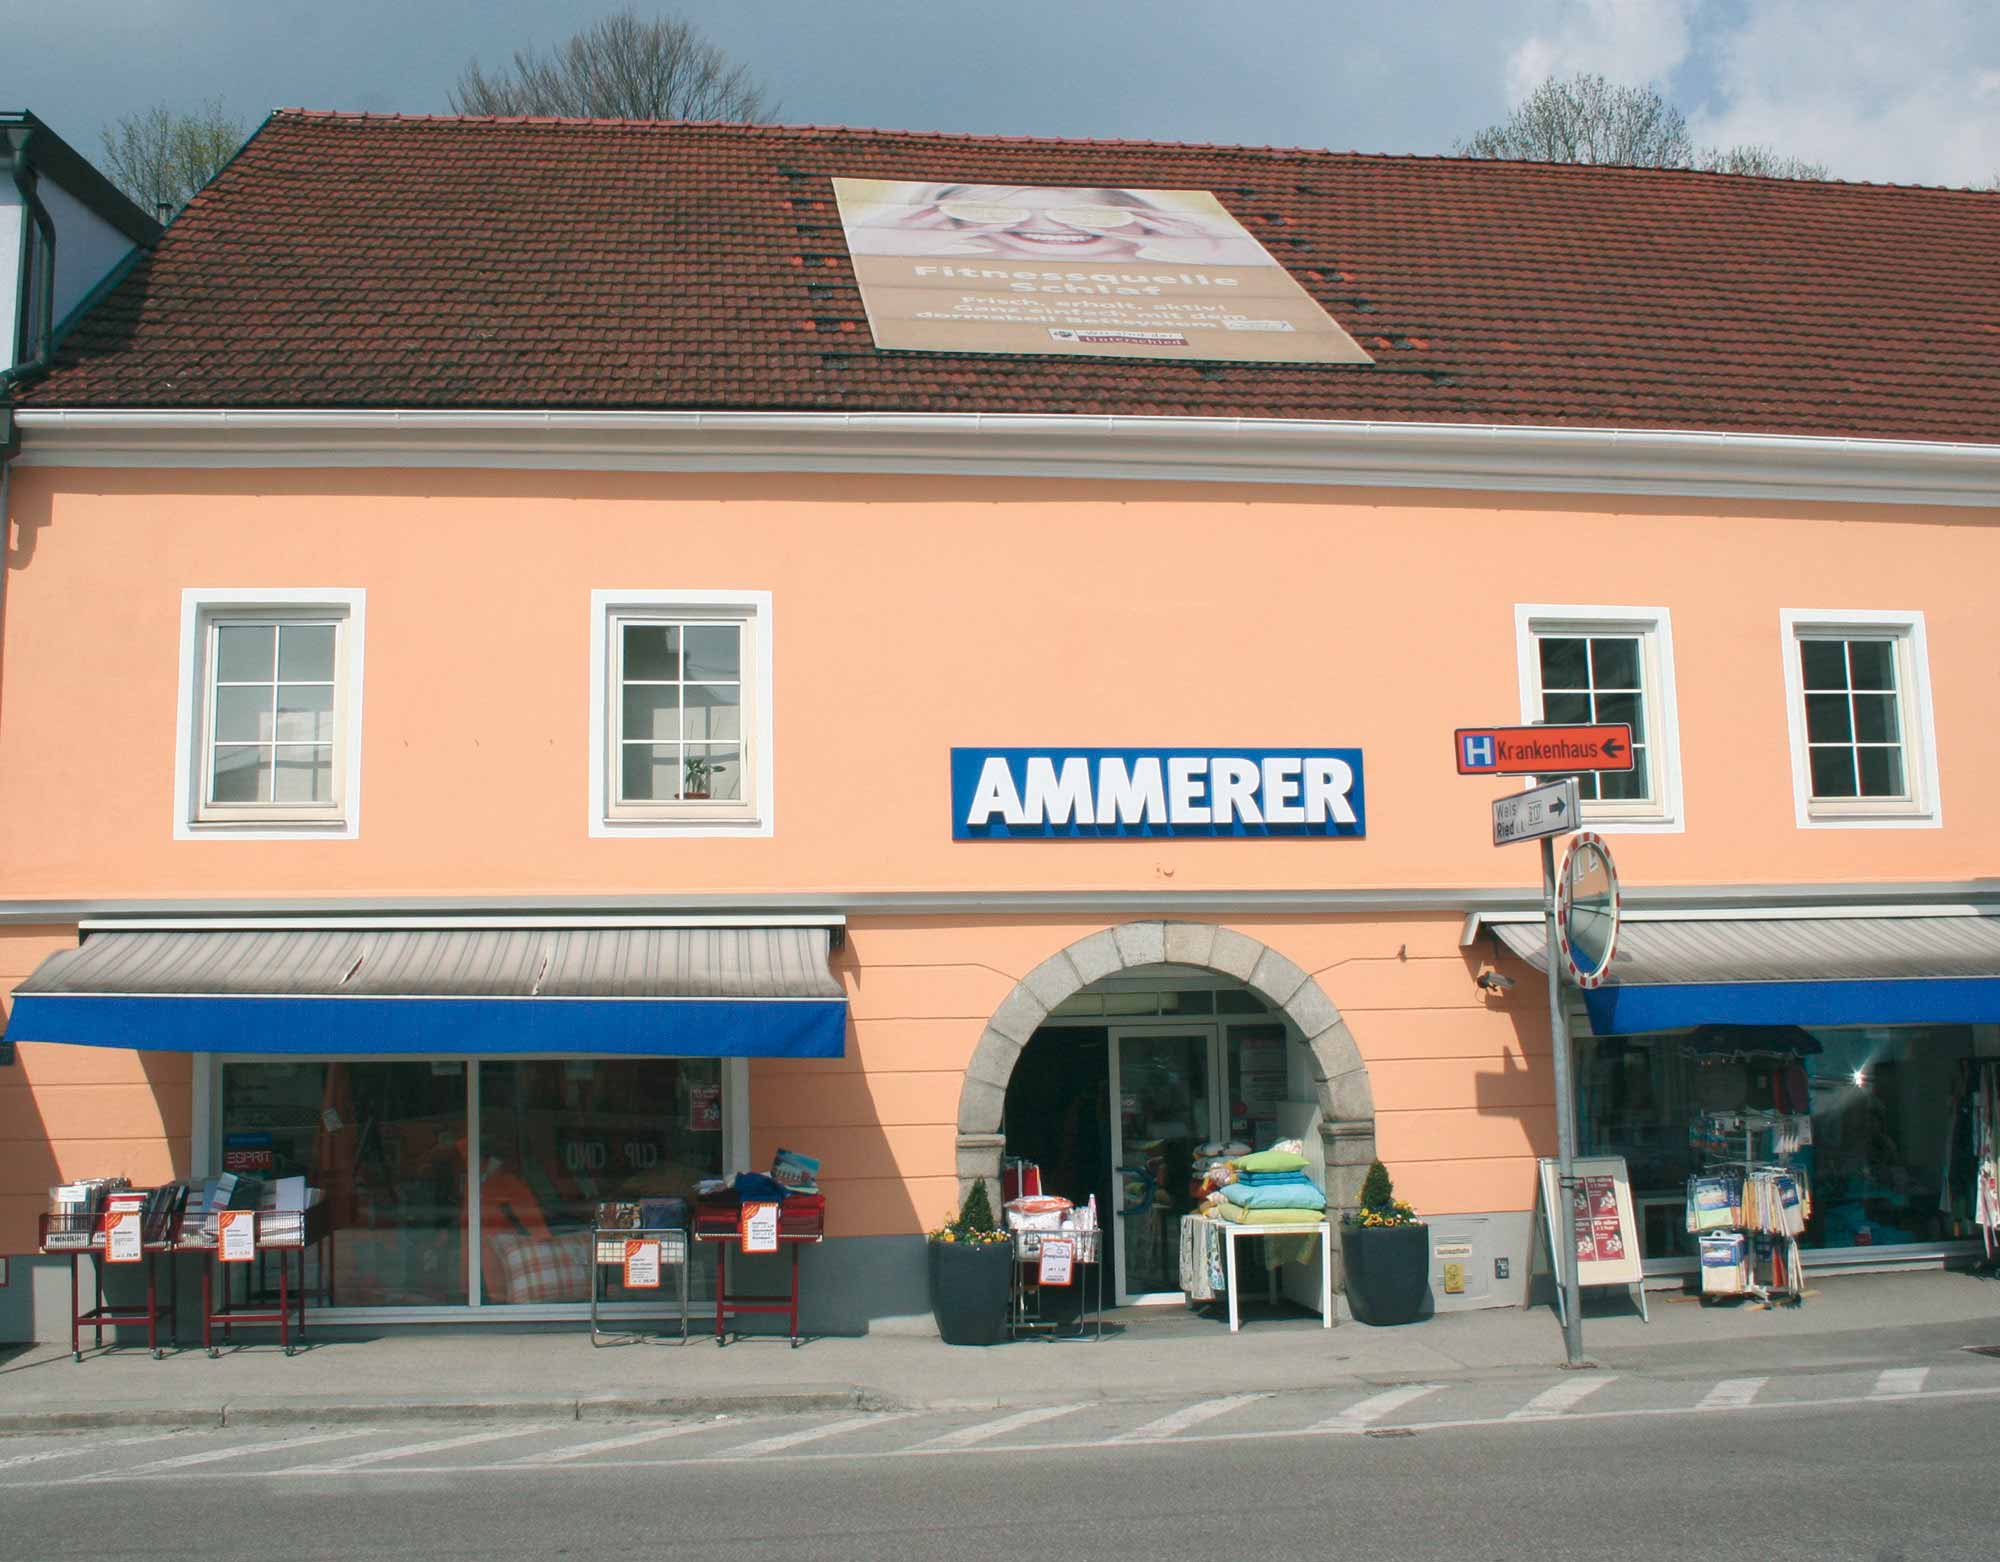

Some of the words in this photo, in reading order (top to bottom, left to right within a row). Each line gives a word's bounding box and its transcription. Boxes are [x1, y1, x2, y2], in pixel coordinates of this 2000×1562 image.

[913, 265, 1238, 286] Fitnessquelle
[1009, 282, 1161, 296] Schlaf
[1028, 308, 1127, 317] einfach
[1137, 311, 1185, 320] mit
[1084, 336, 1183, 346] Unterschied
[1466, 738, 1492, 765] H
[1497, 739, 1598, 761] Krankenhaus
[967, 756, 1358, 825] AMMERER
[1497, 819, 1514, 839] Ried
[226, 1150, 272, 1164] ESPRIT
